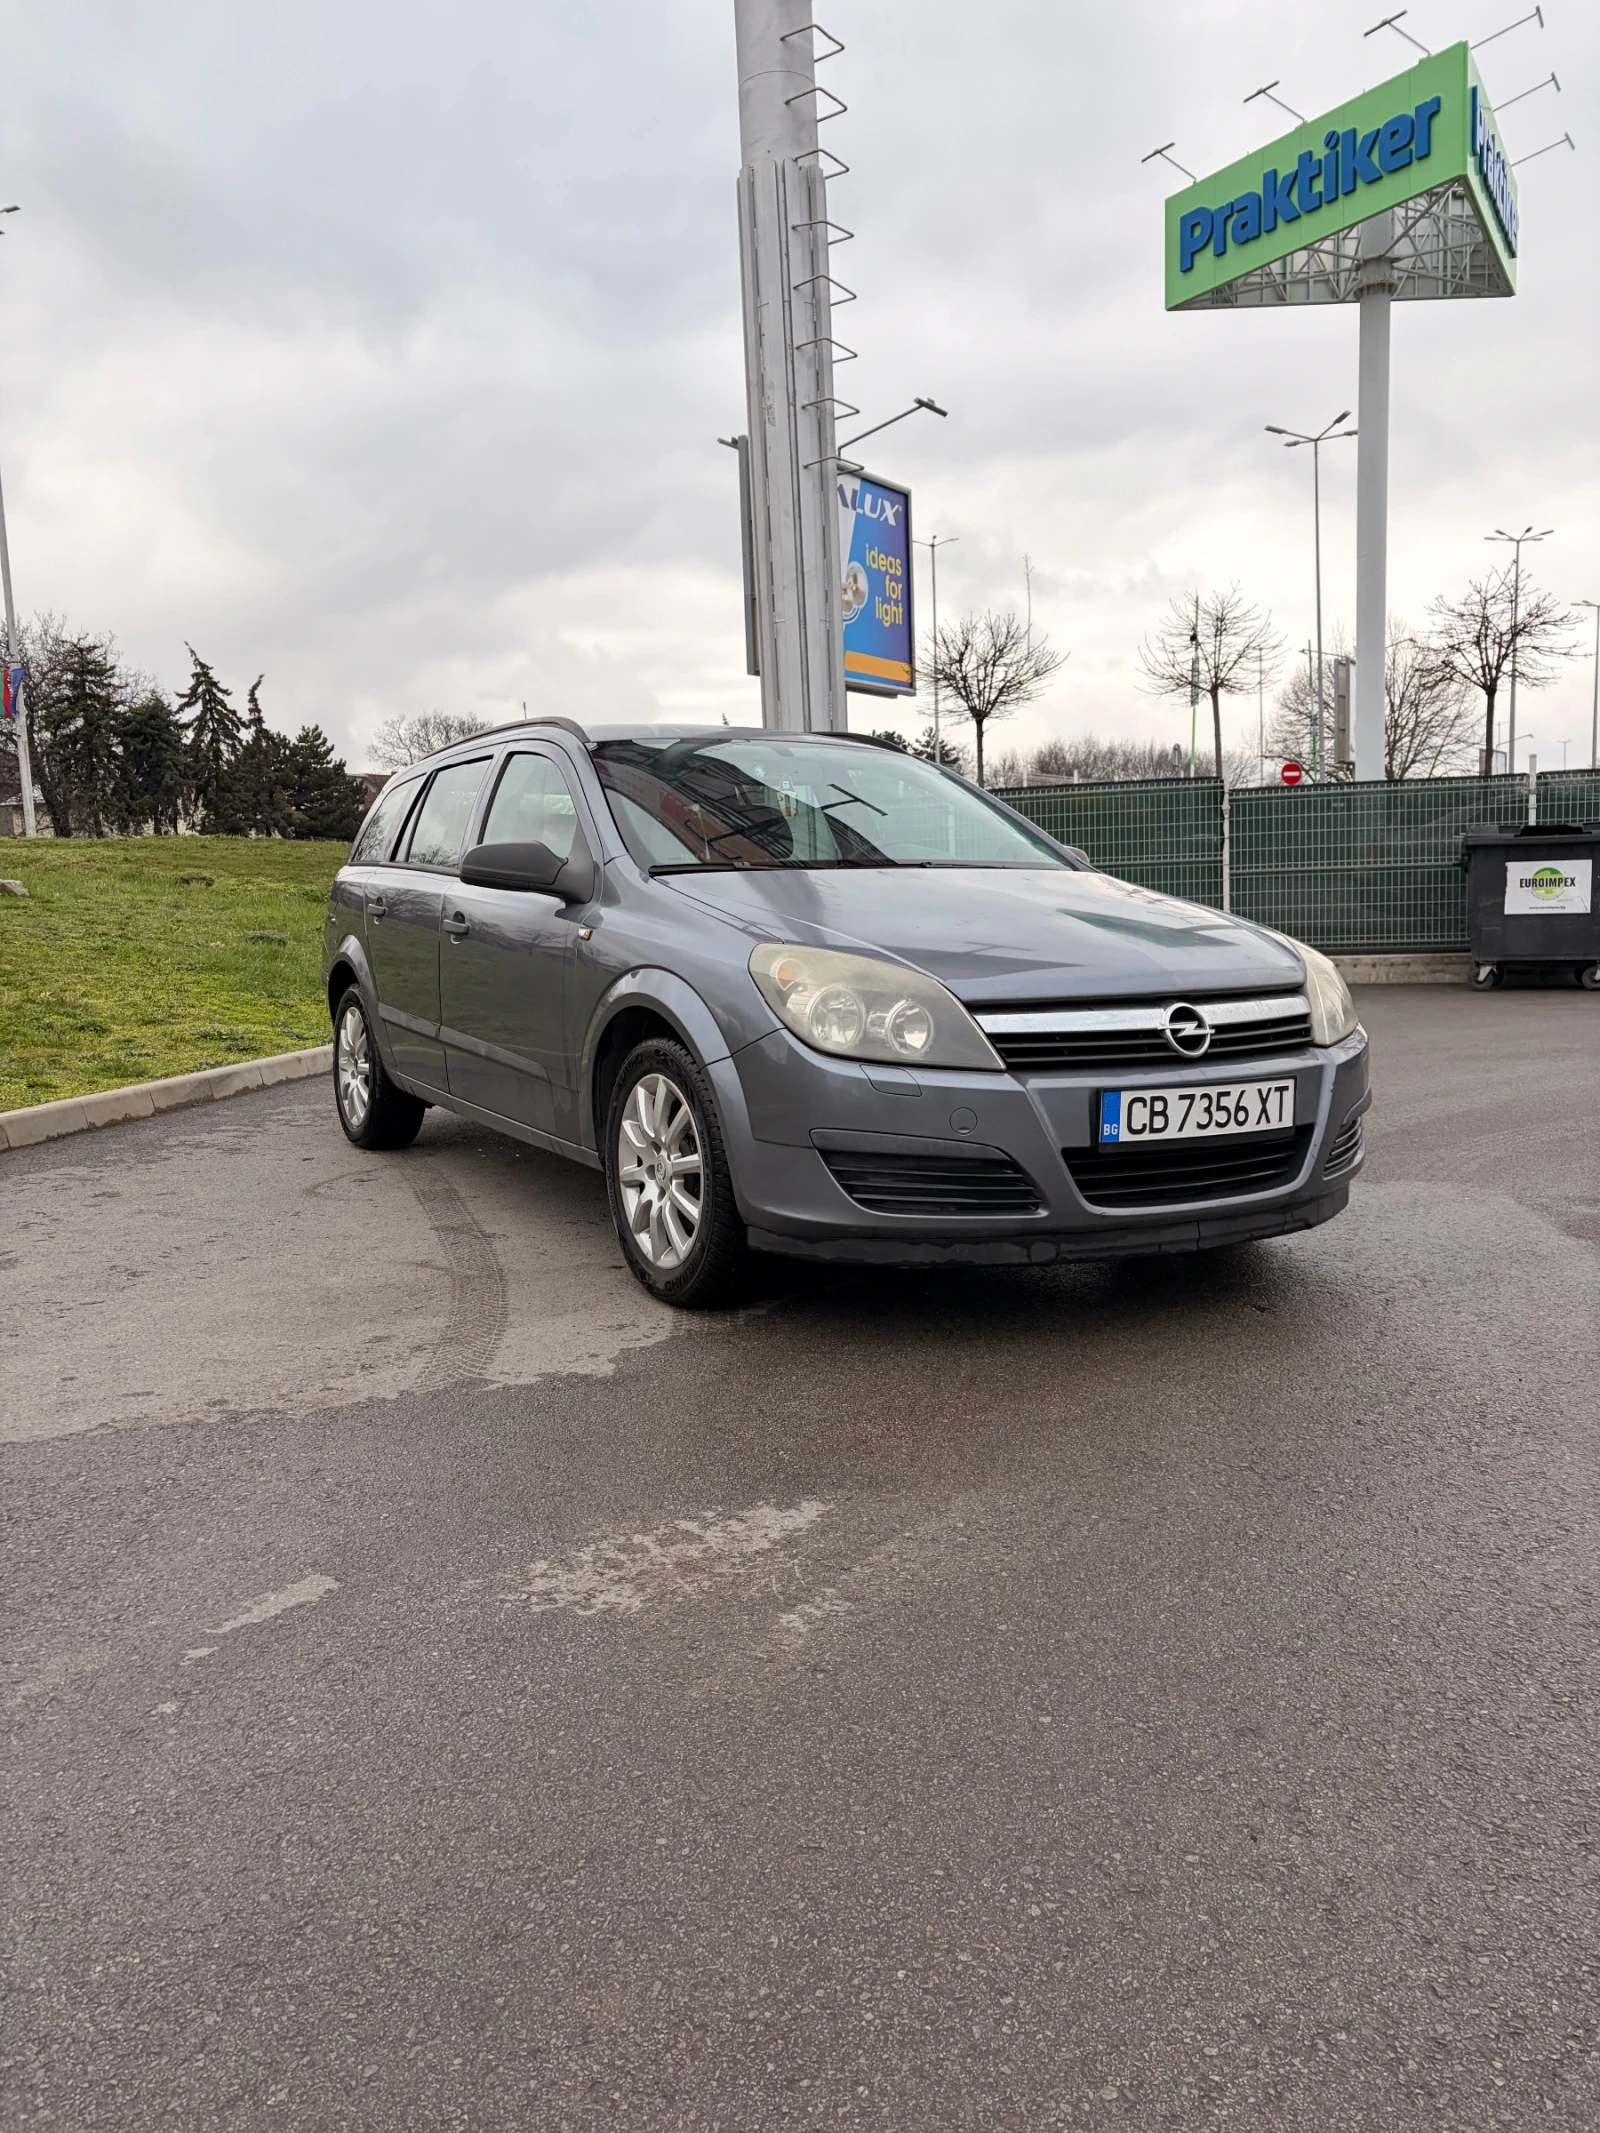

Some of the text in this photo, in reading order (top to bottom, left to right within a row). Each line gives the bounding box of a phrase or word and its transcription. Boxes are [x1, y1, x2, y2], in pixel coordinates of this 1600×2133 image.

[1180, 95, 1441, 273] Praktiker
[865, 543, 902, 576] ideas
[884, 574, 902, 600] for
[874, 596, 903, 627] light
[1519, 877, 1576, 888] EUROIMPEX
[1126, 1085, 1290, 1135] CB 7356 XT
[1103, 1124, 1118, 1136] BG
